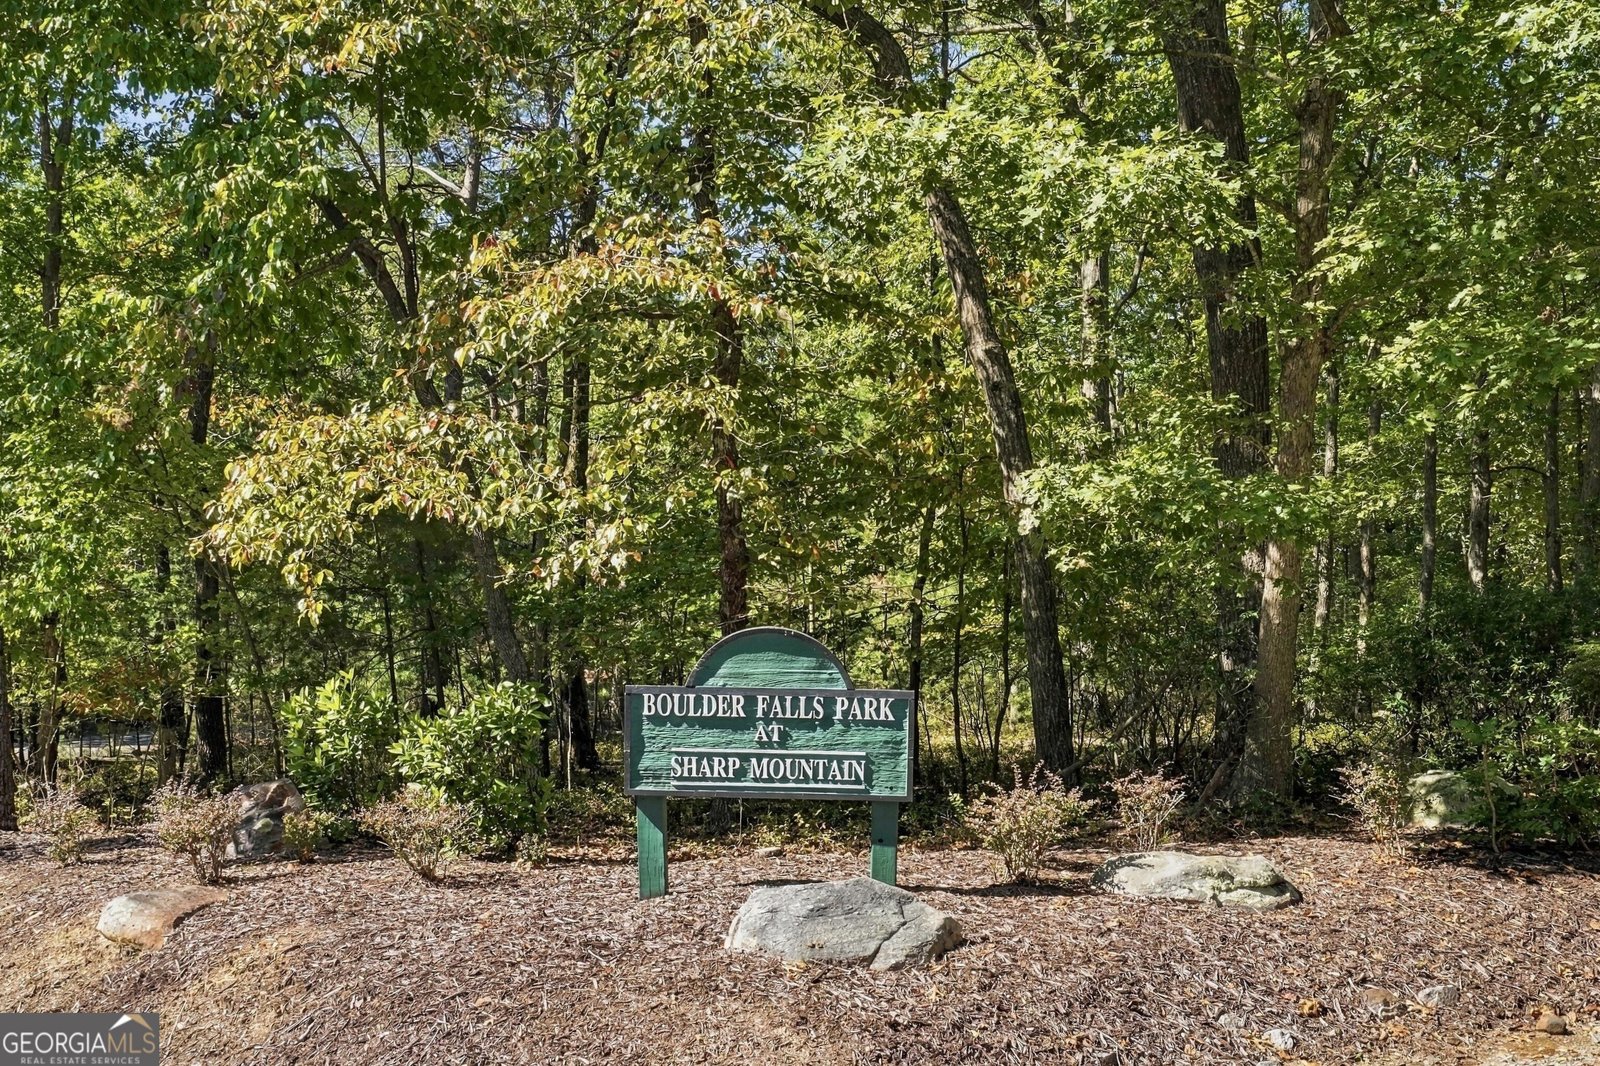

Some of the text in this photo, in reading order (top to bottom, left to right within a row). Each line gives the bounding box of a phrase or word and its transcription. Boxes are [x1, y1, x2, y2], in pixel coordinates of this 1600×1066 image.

[642, 693, 896, 721] BOULDER FALLS PARK
[754, 724, 784, 742] AT
[670, 756, 866, 781] SHARP MOUNTAIN
